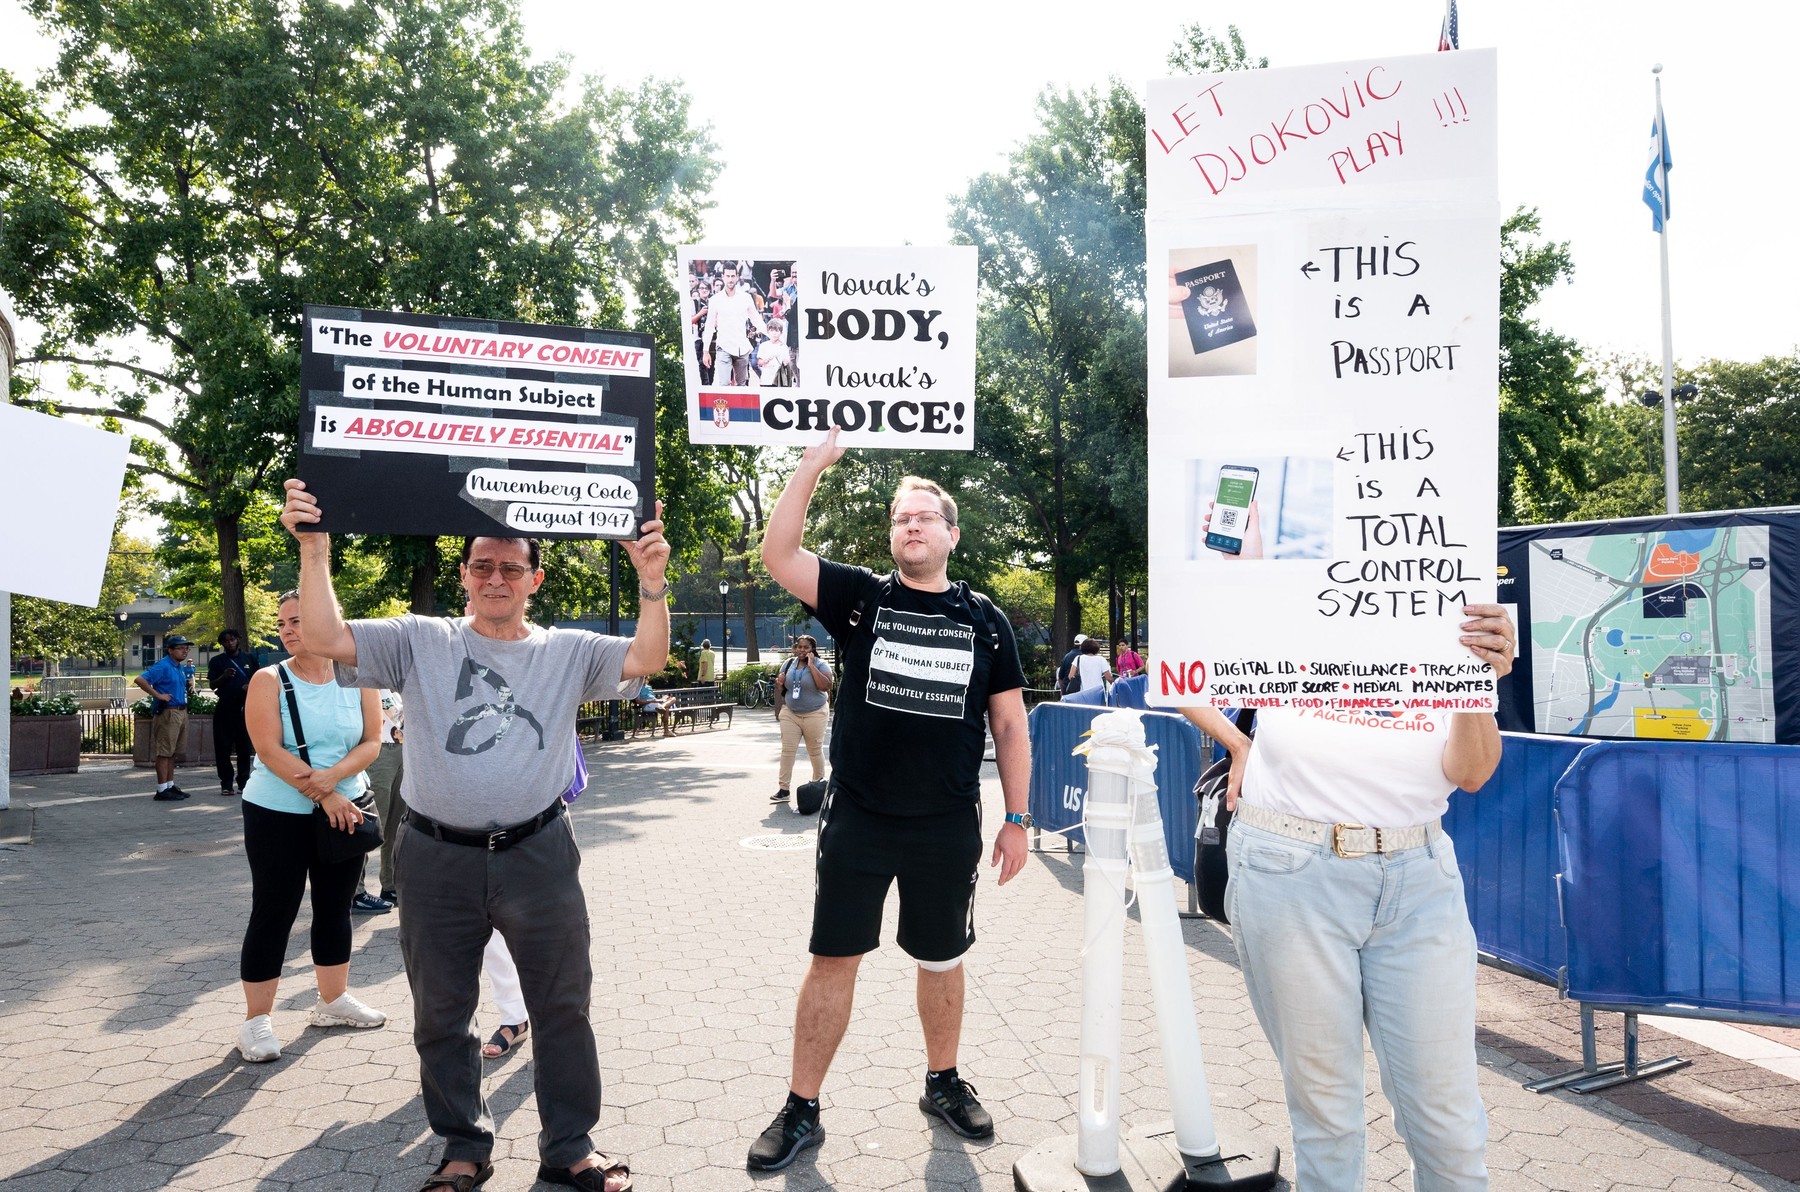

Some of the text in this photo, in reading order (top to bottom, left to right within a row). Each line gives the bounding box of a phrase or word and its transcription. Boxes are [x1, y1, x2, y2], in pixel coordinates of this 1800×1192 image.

[1151, 81, 1224, 154] LET
[1189, 65, 1402, 195] DJOKOVIC
[1328, 86, 1470, 184] PLAY !!!
[1185, 271, 1226, 288] PASSPORT
[1407, 294, 1430, 317] A
[805, 308, 949, 350] BODY,
[382, 331, 533, 360] VOLUNTARY
[537, 348, 644, 368] CONSENT
[1331, 340, 1461, 378] PASSPORT
[352, 373, 596, 408] of the Human Subject
[320, 416, 337, 434] is
[344, 417, 506, 444] ABSOLUTELY
[763, 398, 965, 435] CHOICE!
[471, 474, 633, 501] Nuremberg Code
[1417, 477, 1440, 497] A
[513, 506, 630, 529] August 1947
[1346, 513, 1467, 551] TOTAL
[1327, 558, 1481, 584] CONTROL
[1317, 588, 1469, 618] SYSTEM
[877, 621, 973, 640] THE VOLUNTARY CONSENT
[874, 647, 971, 672] OF THE HUMAN SUBJECT
[1161, 660, 1206, 696] NO
[1214, 658, 1273, 676] DIGITAL
[1310, 660, 1408, 676] SURVEILLANCE
[1419, 656, 1492, 676] TRACKING
[1210, 680, 1494, 696] SOCIAL CREDIT SCORE MEDICAL MANDATES
[869, 681, 963, 704] IS ABSOLUTELY ESSENTIAL
[1238, 697, 1285, 708] TRAVEL
[1291, 698, 1323, 708] FOOD
[1330, 698, 1394, 708] FINANCES
[1402, 697, 1493, 709] VACCINATIONS
